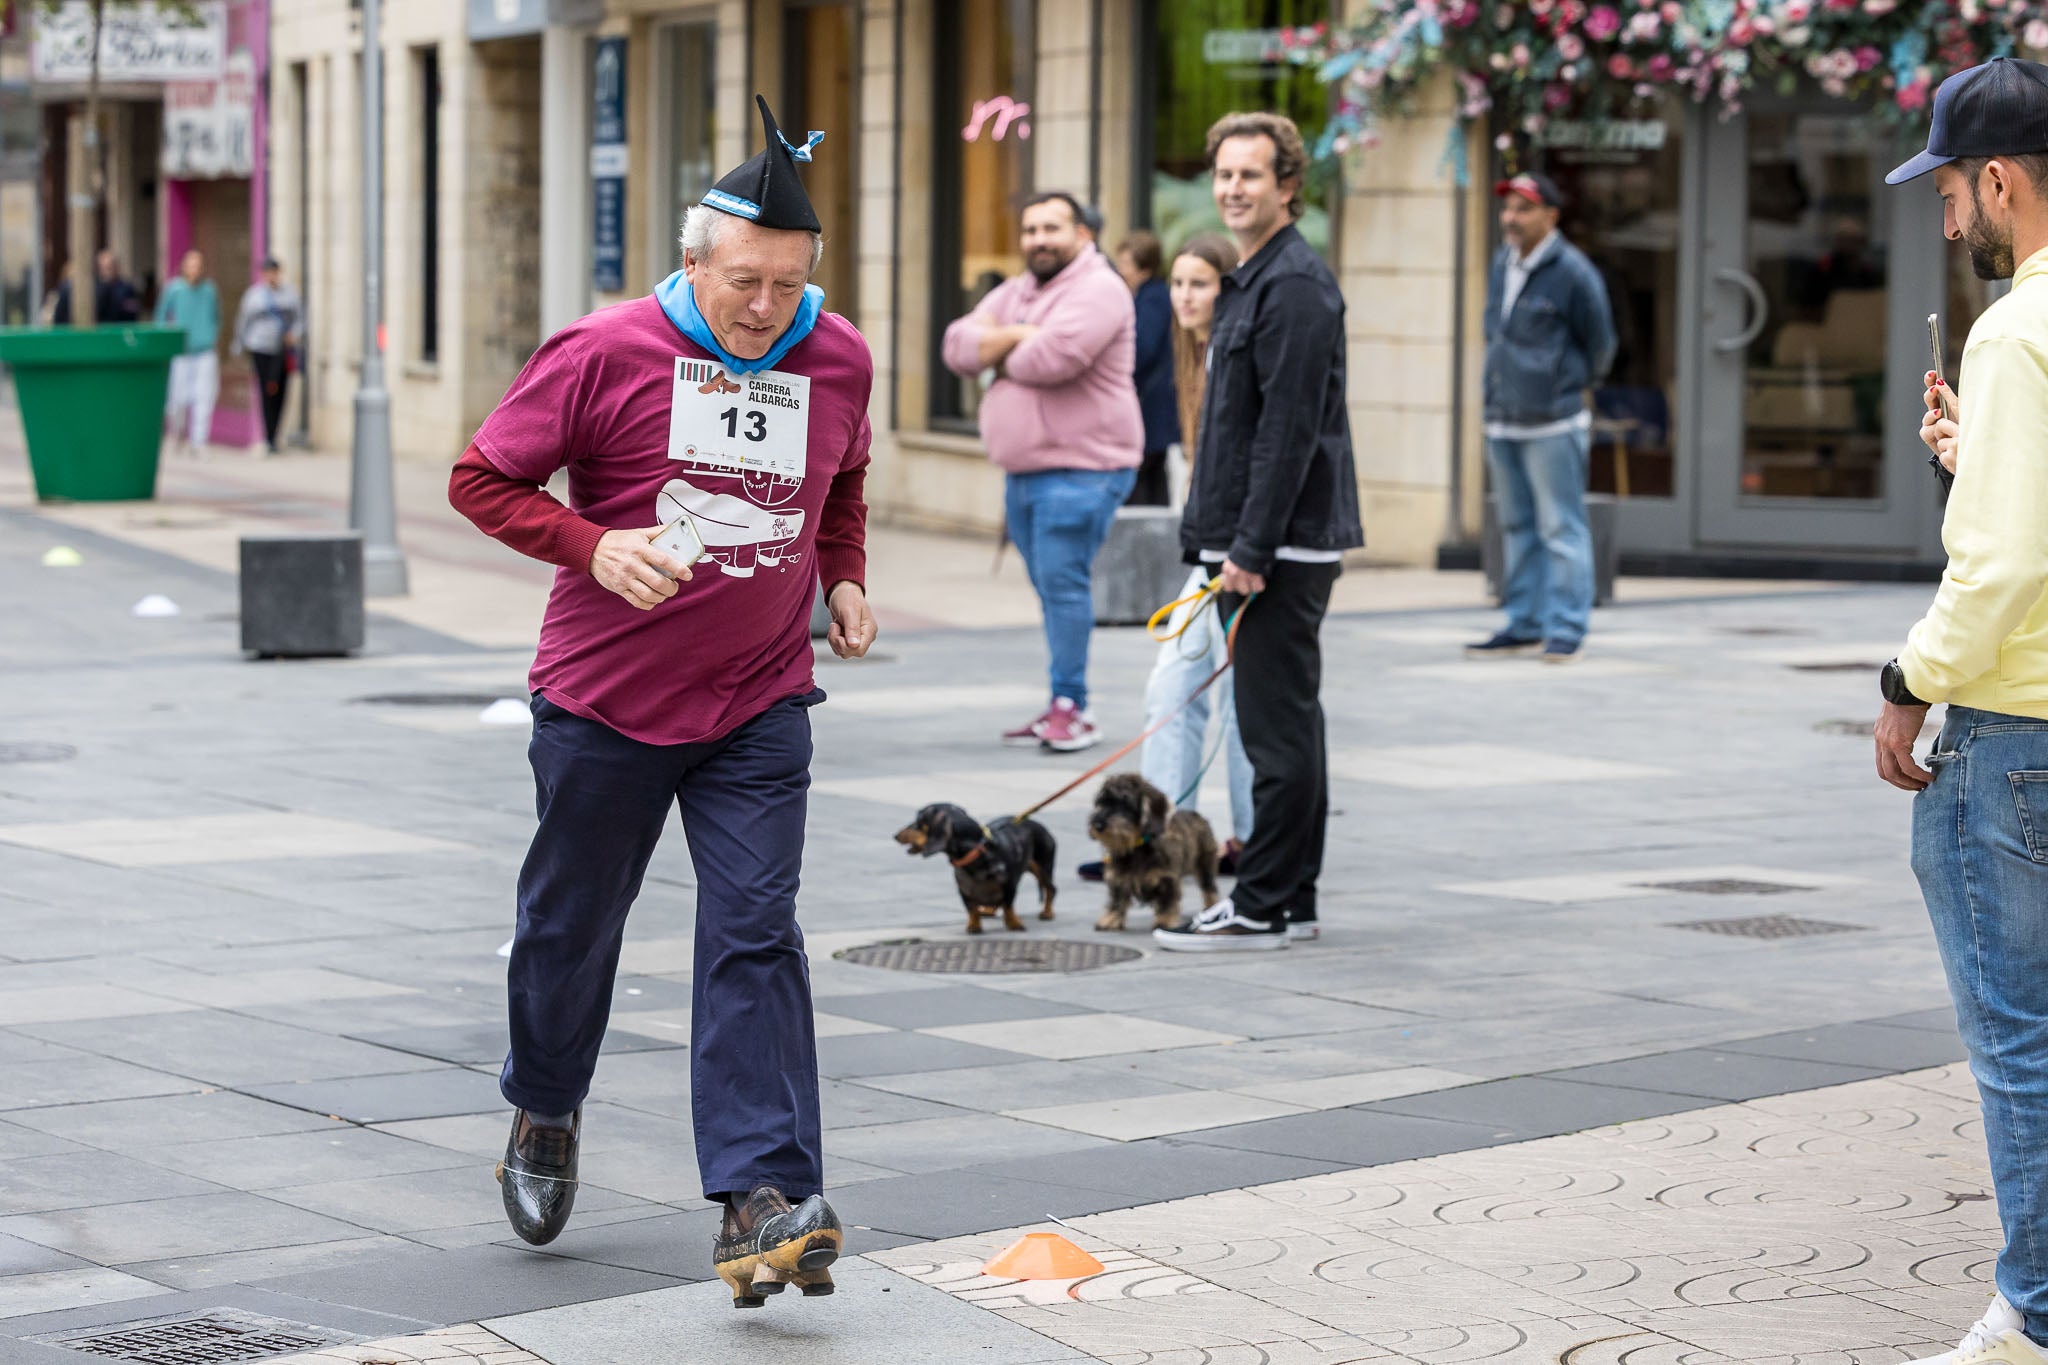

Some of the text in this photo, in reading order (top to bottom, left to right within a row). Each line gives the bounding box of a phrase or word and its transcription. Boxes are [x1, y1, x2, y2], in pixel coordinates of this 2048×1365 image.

[749, 380, 791, 396] CARRERA
[748, 391, 800, 409] ALBARCAS
[720, 406, 768, 442] 13
